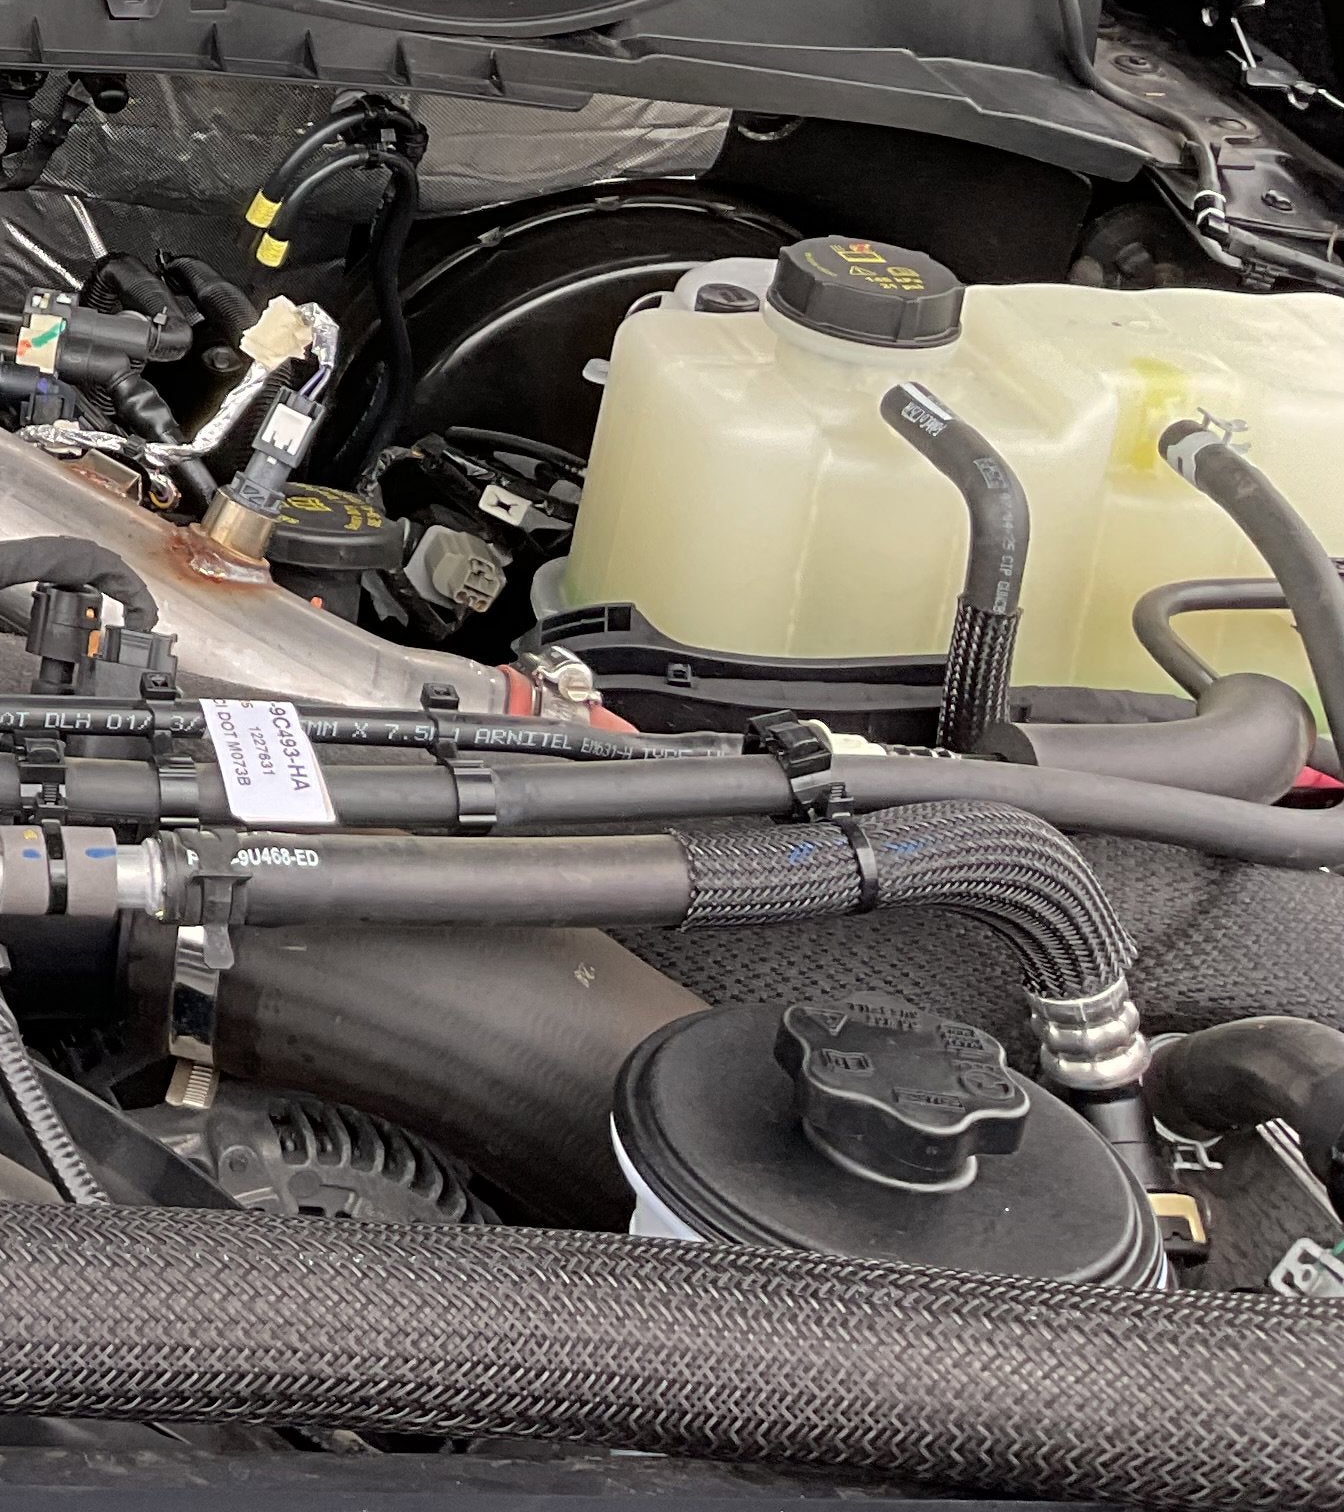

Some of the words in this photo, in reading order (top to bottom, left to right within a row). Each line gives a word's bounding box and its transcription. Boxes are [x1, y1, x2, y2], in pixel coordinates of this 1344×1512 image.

[44, 712, 91, 730] DLH
[352, 721, 369, 740] X
[474, 728, 572, 751] ARNITEL
[217, 711, 238, 738] DOT
[187, 847, 319, 866] P-9U468-ED
